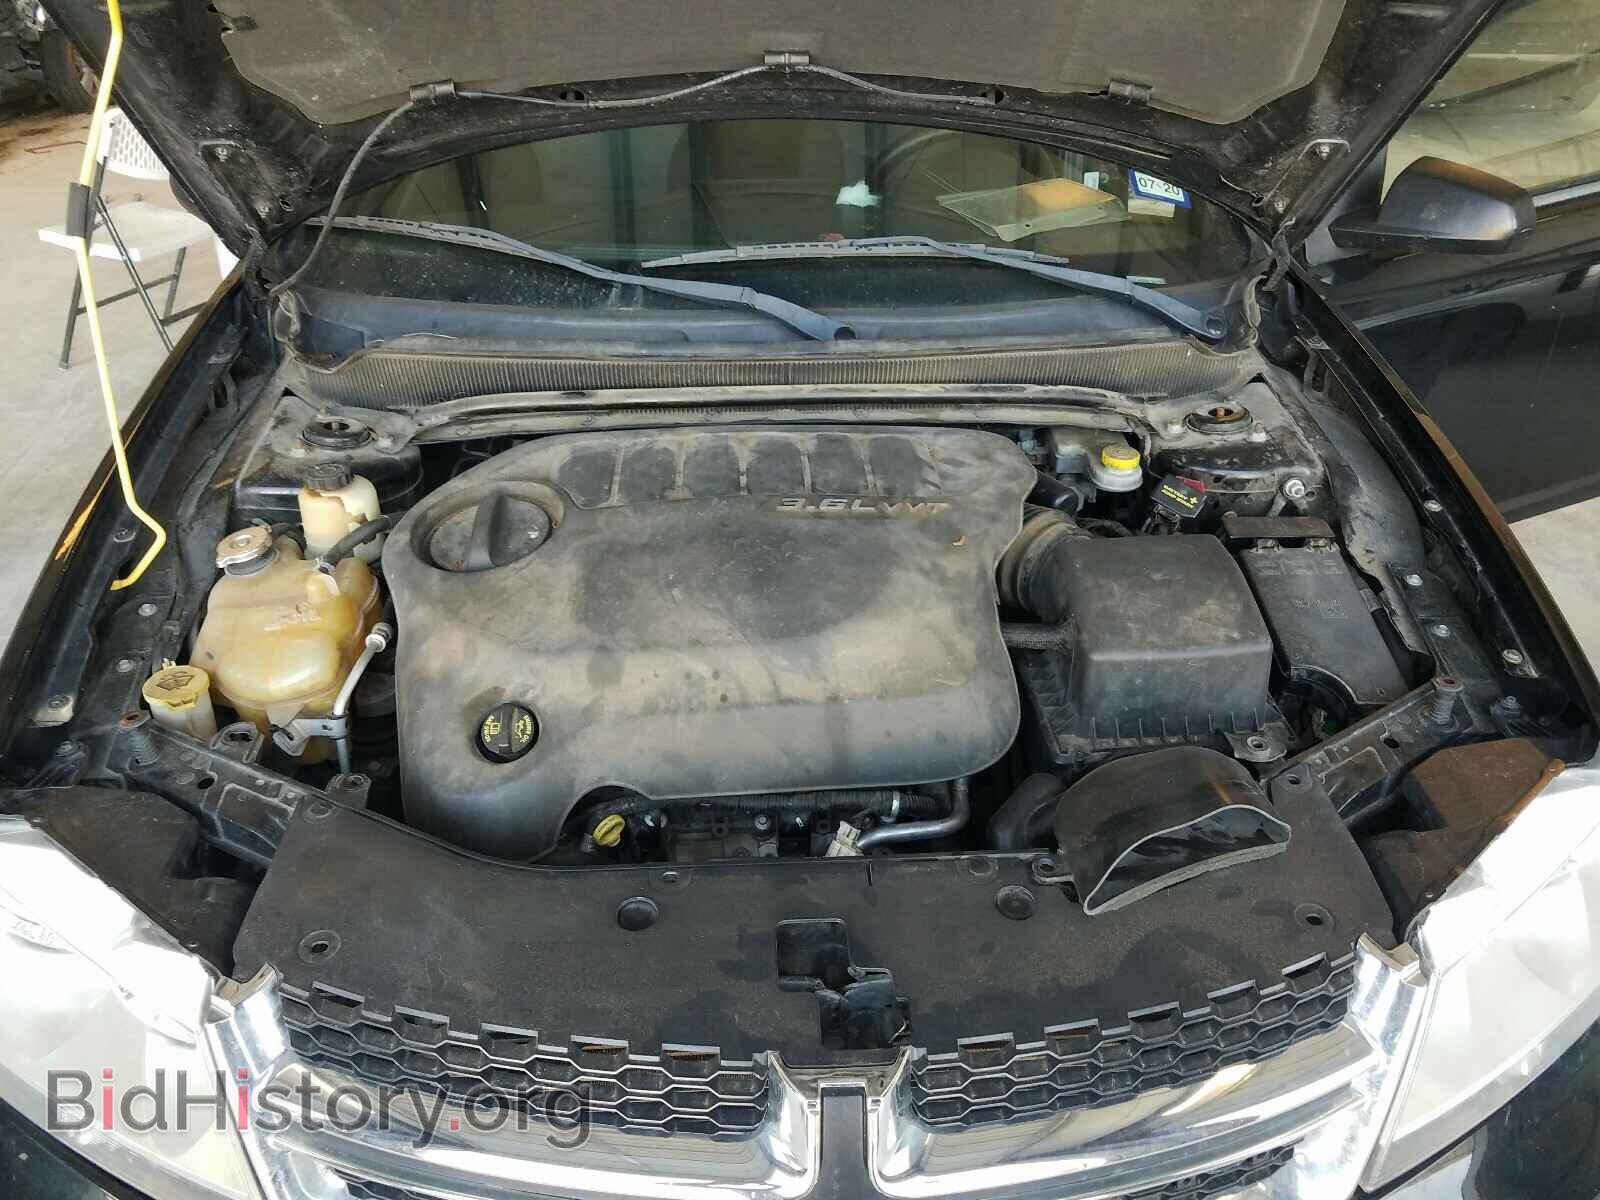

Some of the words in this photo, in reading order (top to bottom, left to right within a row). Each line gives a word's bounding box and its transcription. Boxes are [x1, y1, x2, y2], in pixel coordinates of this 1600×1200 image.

[1139, 177, 1154, 189] 07
[1164, 182, 1180, 195] 20
[776, 498, 876, 512] 3.6L
